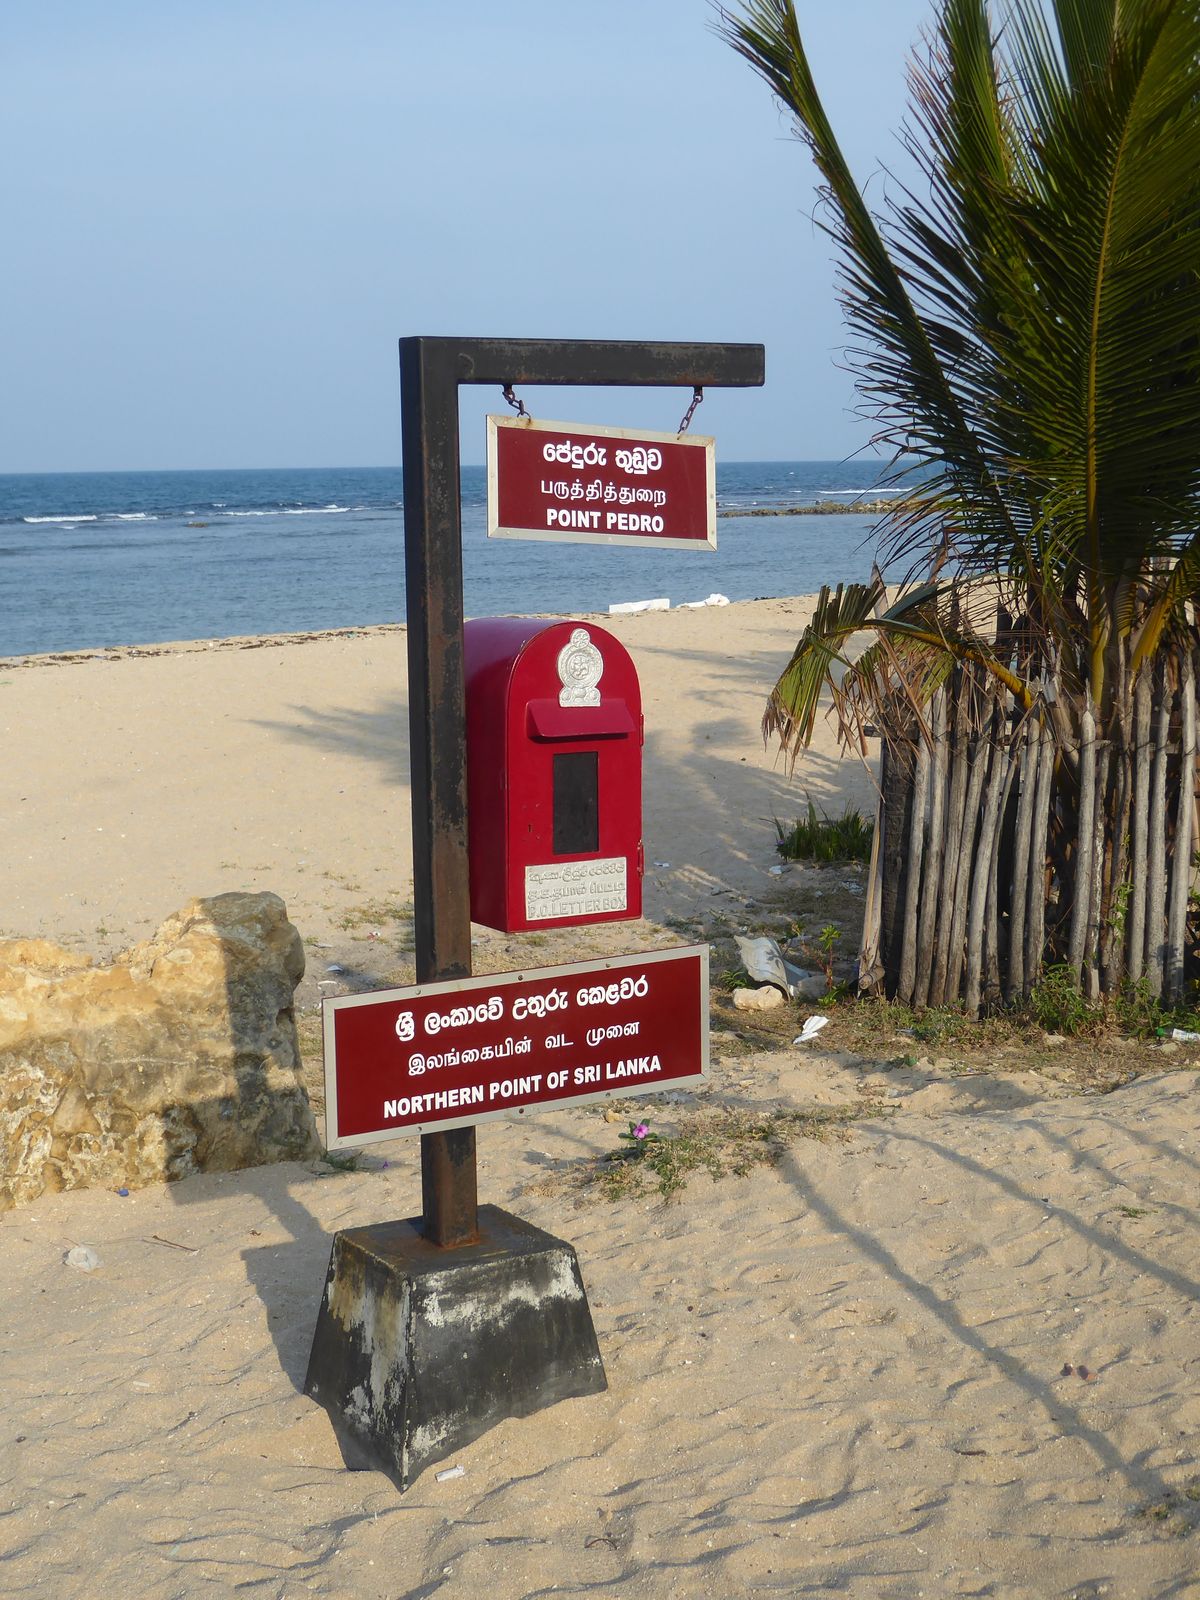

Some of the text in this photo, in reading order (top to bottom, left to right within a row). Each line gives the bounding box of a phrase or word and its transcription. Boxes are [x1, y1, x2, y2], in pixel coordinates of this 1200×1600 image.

[543, 440, 662, 475] පේදුරු තුඩුව
[541, 479, 667, 508] பருத்தித்துறை
[546, 508, 665, 533] POINT PEDRO
[602, 895, 626, 911] BOX
[424, 996, 504, 1034] ලංකාවේ
[512, 988, 569, 1021] උතුරු
[577, 975, 649, 1007] කෙළවර
[408, 1022, 641, 1077] இலங்கையின் வட முனை
[384, 1055, 661, 1118] NORTHERN POINT OF SRI LANKA
